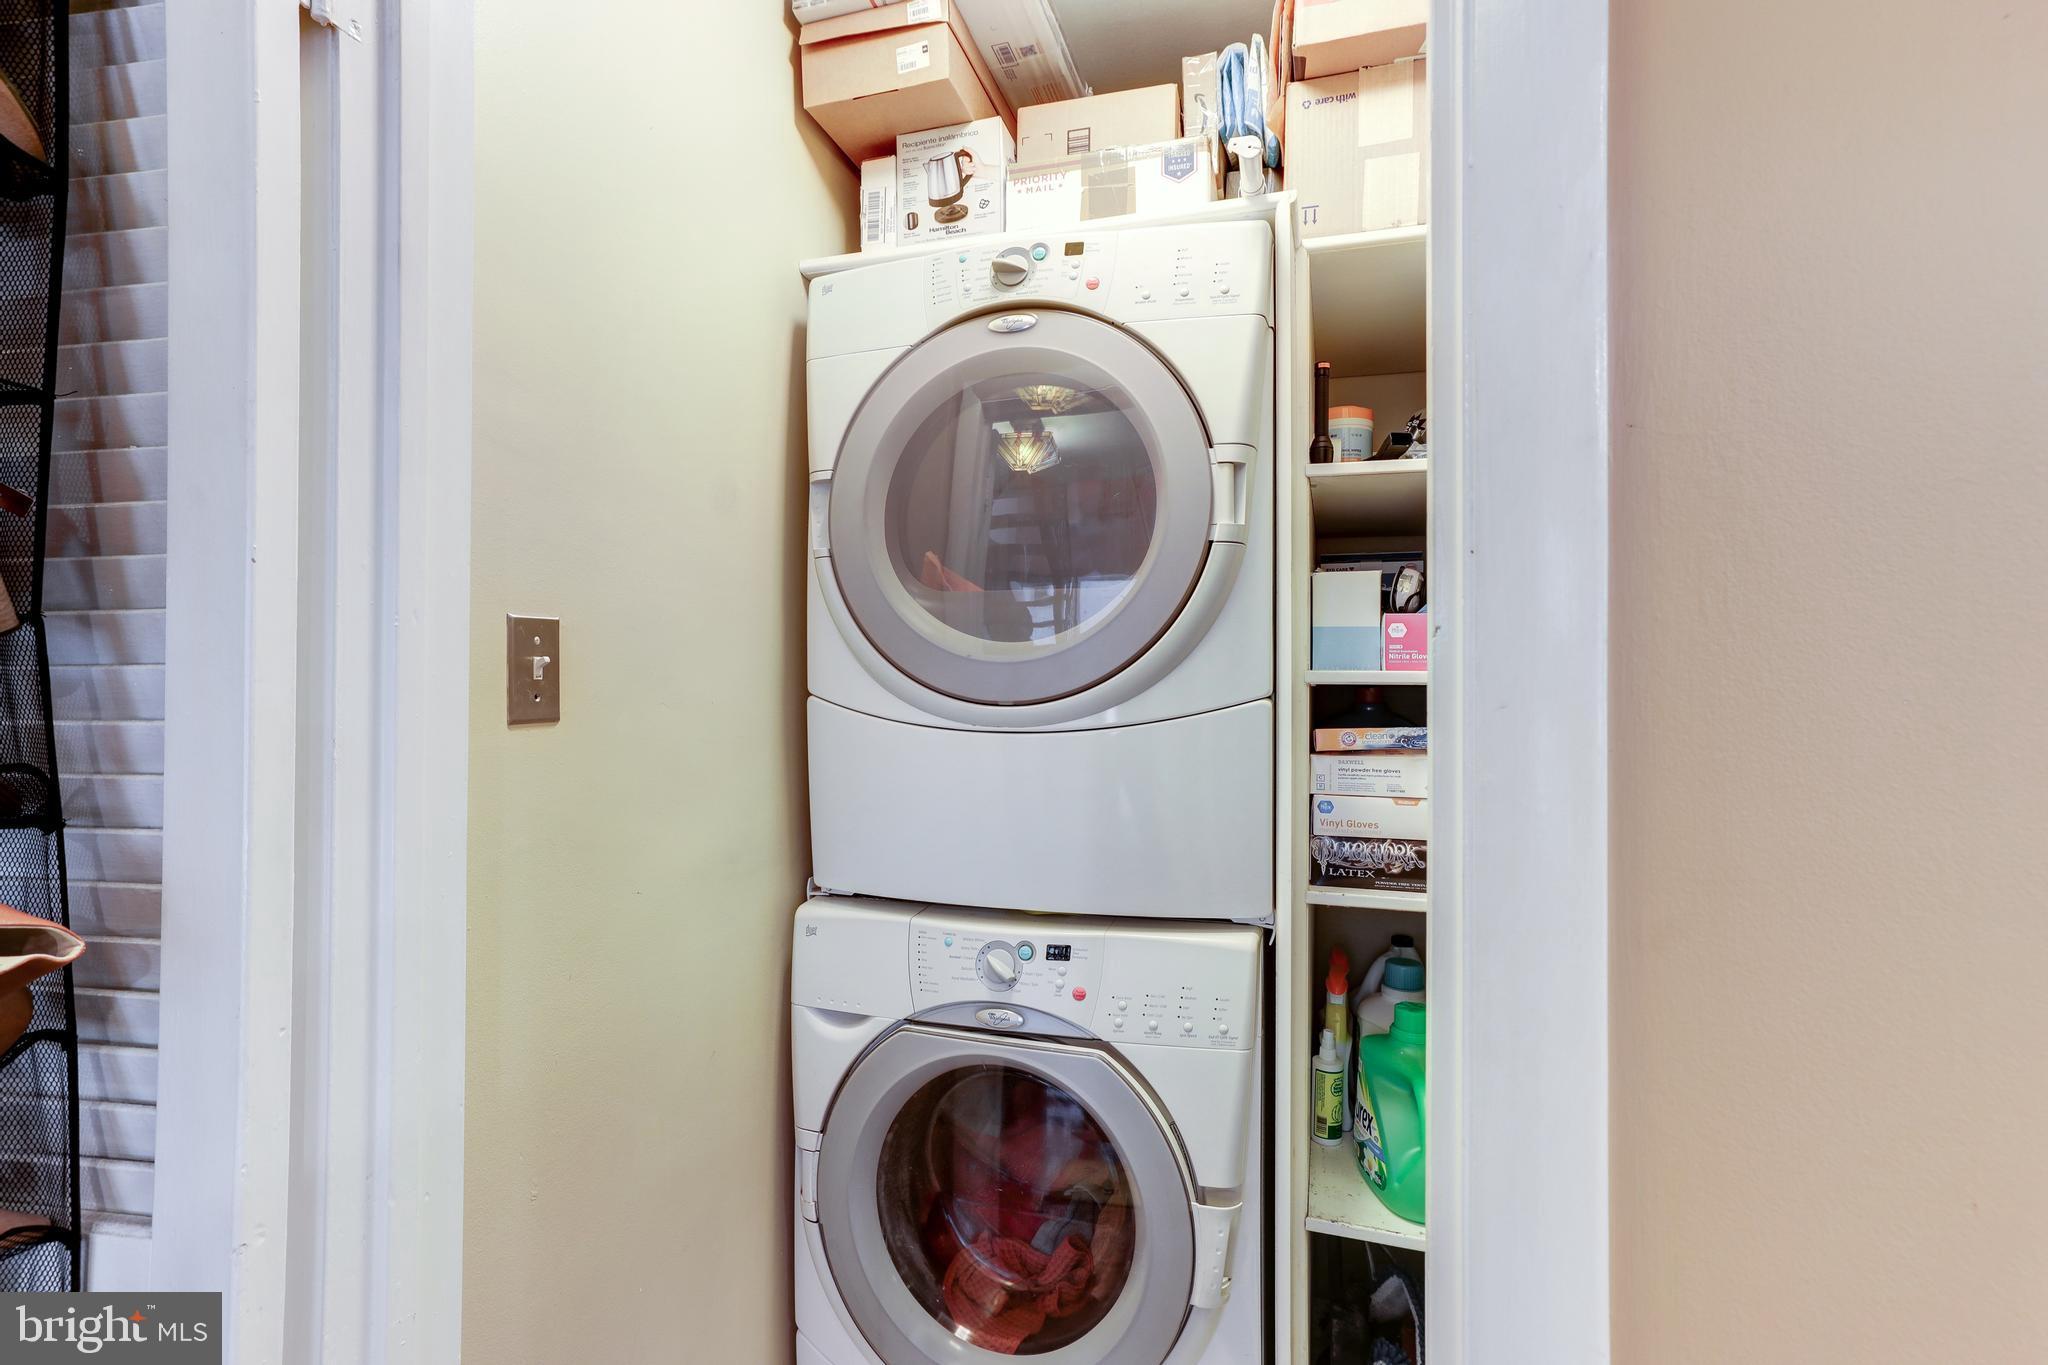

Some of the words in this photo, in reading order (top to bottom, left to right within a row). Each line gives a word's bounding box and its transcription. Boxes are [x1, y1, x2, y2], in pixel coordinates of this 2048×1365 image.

[1315, 96, 1334, 105] care
[1335, 92, 1356, 103] with
[902, 137, 937, 149] Recipiente
[1013, 171, 1067, 187] PRIORITY
[1025, 183, 1054, 194] MAIL
[929, 224, 959, 233] Hamilton
[945, 227, 967, 235] Beach
[1364, 732, 1388, 740] clean
[1320, 819, 1343, 829] Vinyl
[1346, 820, 1379, 830] Gloves
[1329, 867, 1376, 879] LATEX
